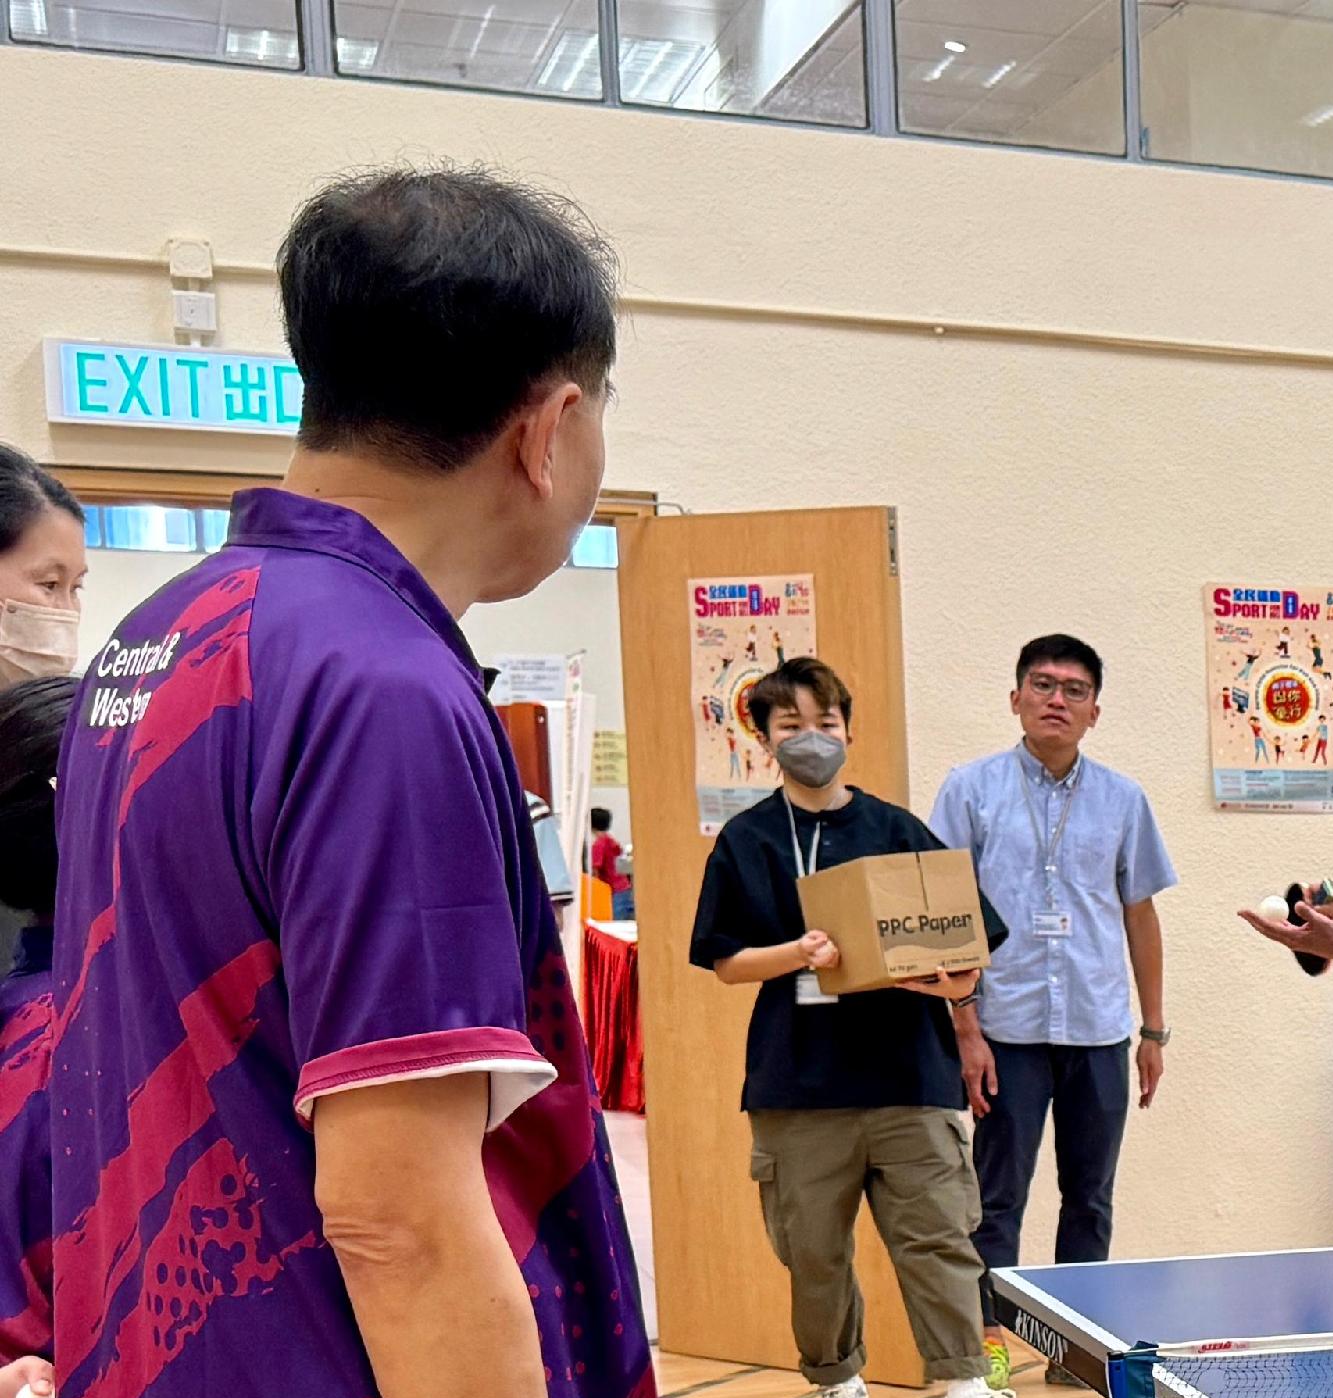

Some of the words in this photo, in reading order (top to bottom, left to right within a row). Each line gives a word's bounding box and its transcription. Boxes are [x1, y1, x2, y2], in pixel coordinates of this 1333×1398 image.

[76, 351, 210, 418] EXIT
[97, 634, 170, 678] Central
[877, 916, 915, 938] PPC
[918, 913, 972, 935] Paper
